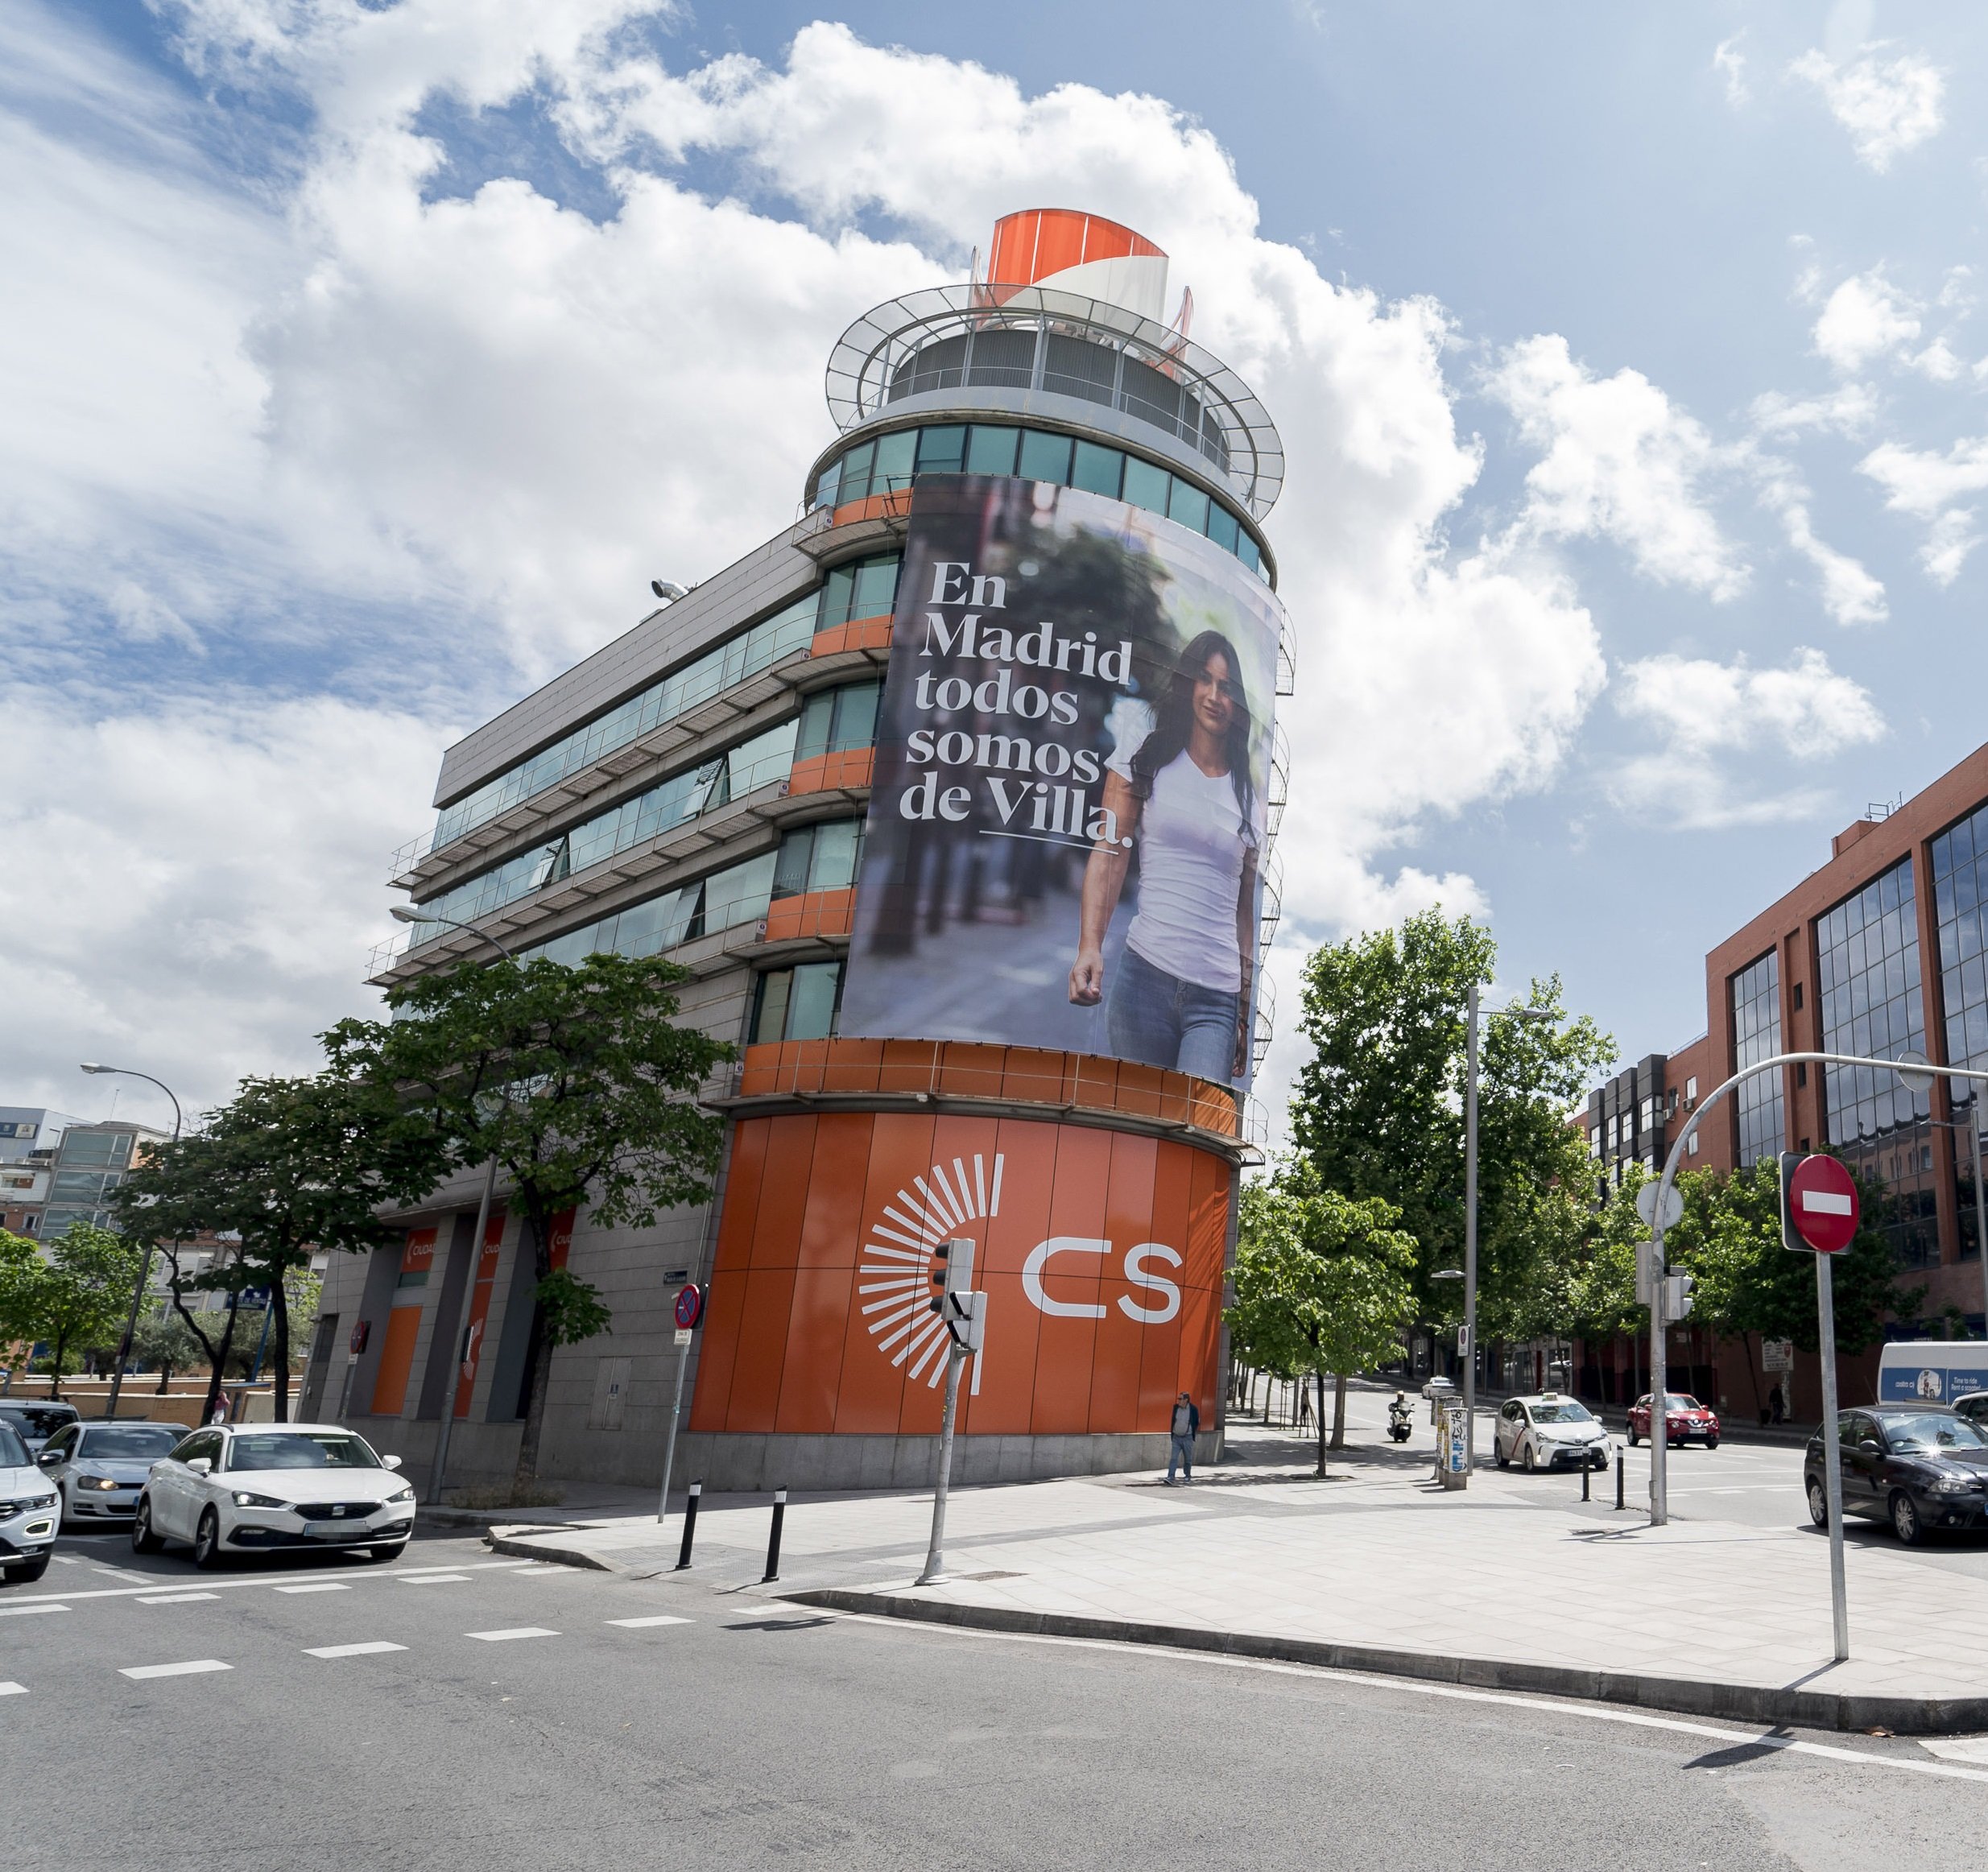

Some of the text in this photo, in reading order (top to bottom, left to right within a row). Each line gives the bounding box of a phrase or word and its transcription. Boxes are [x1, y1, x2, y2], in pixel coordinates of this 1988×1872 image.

[927, 561, 1007, 610] En
[918, 612, 1133, 686] Madrid
[915, 668, 1080, 725] todos
[906, 729, 1101, 783] somos
[899, 771, 1134, 849] de Villa.
[1022, 1236, 1184, 1324] CS
